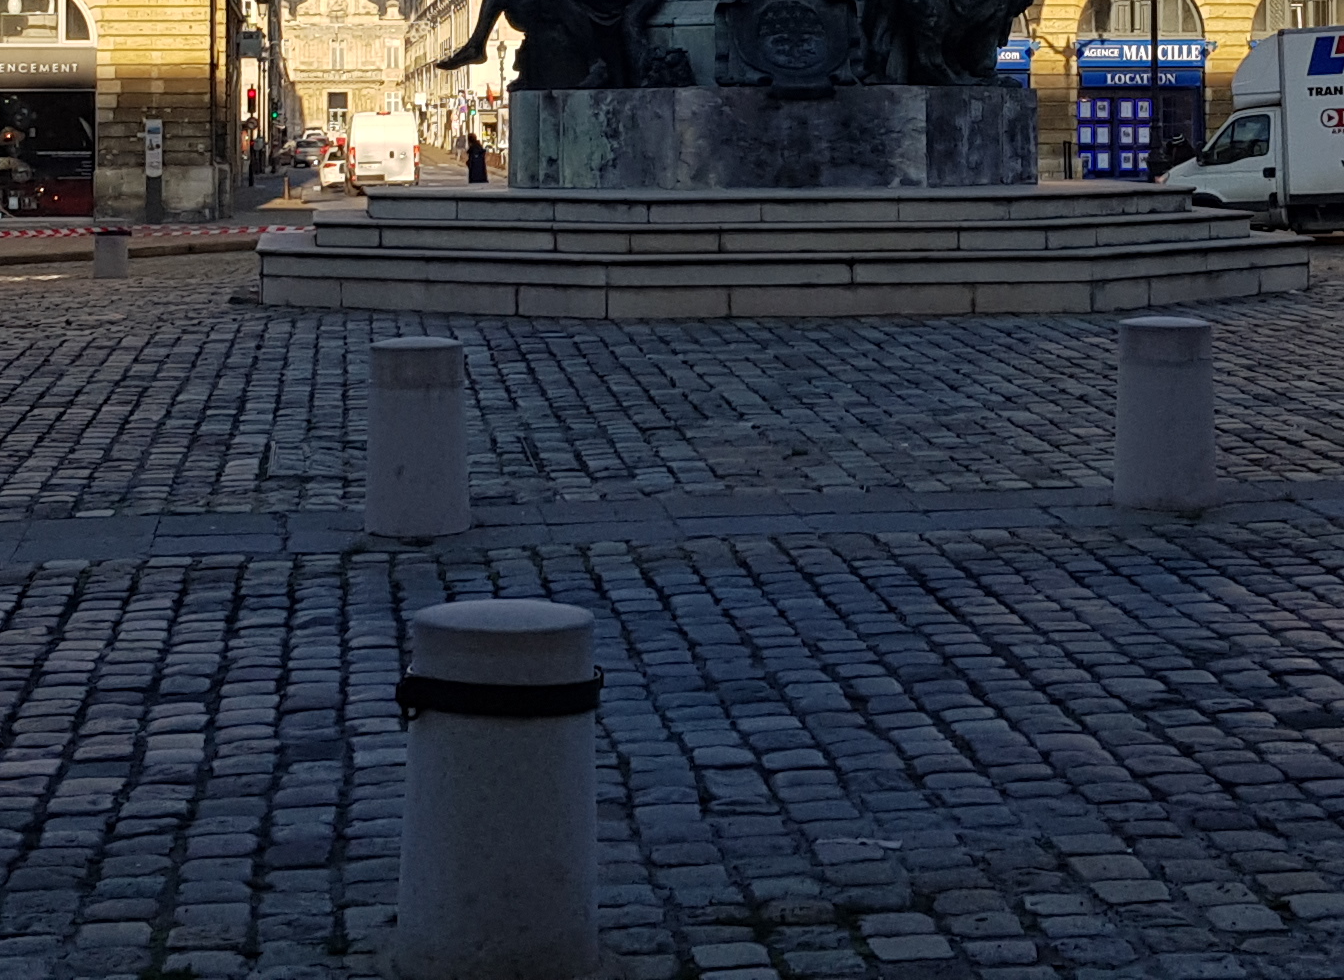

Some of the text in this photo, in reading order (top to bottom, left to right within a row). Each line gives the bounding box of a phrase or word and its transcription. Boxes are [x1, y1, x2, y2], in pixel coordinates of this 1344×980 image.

[1084, 44, 1202, 61] AGENCE MACILLE
[1106, 73, 1177, 85] LOCATON
